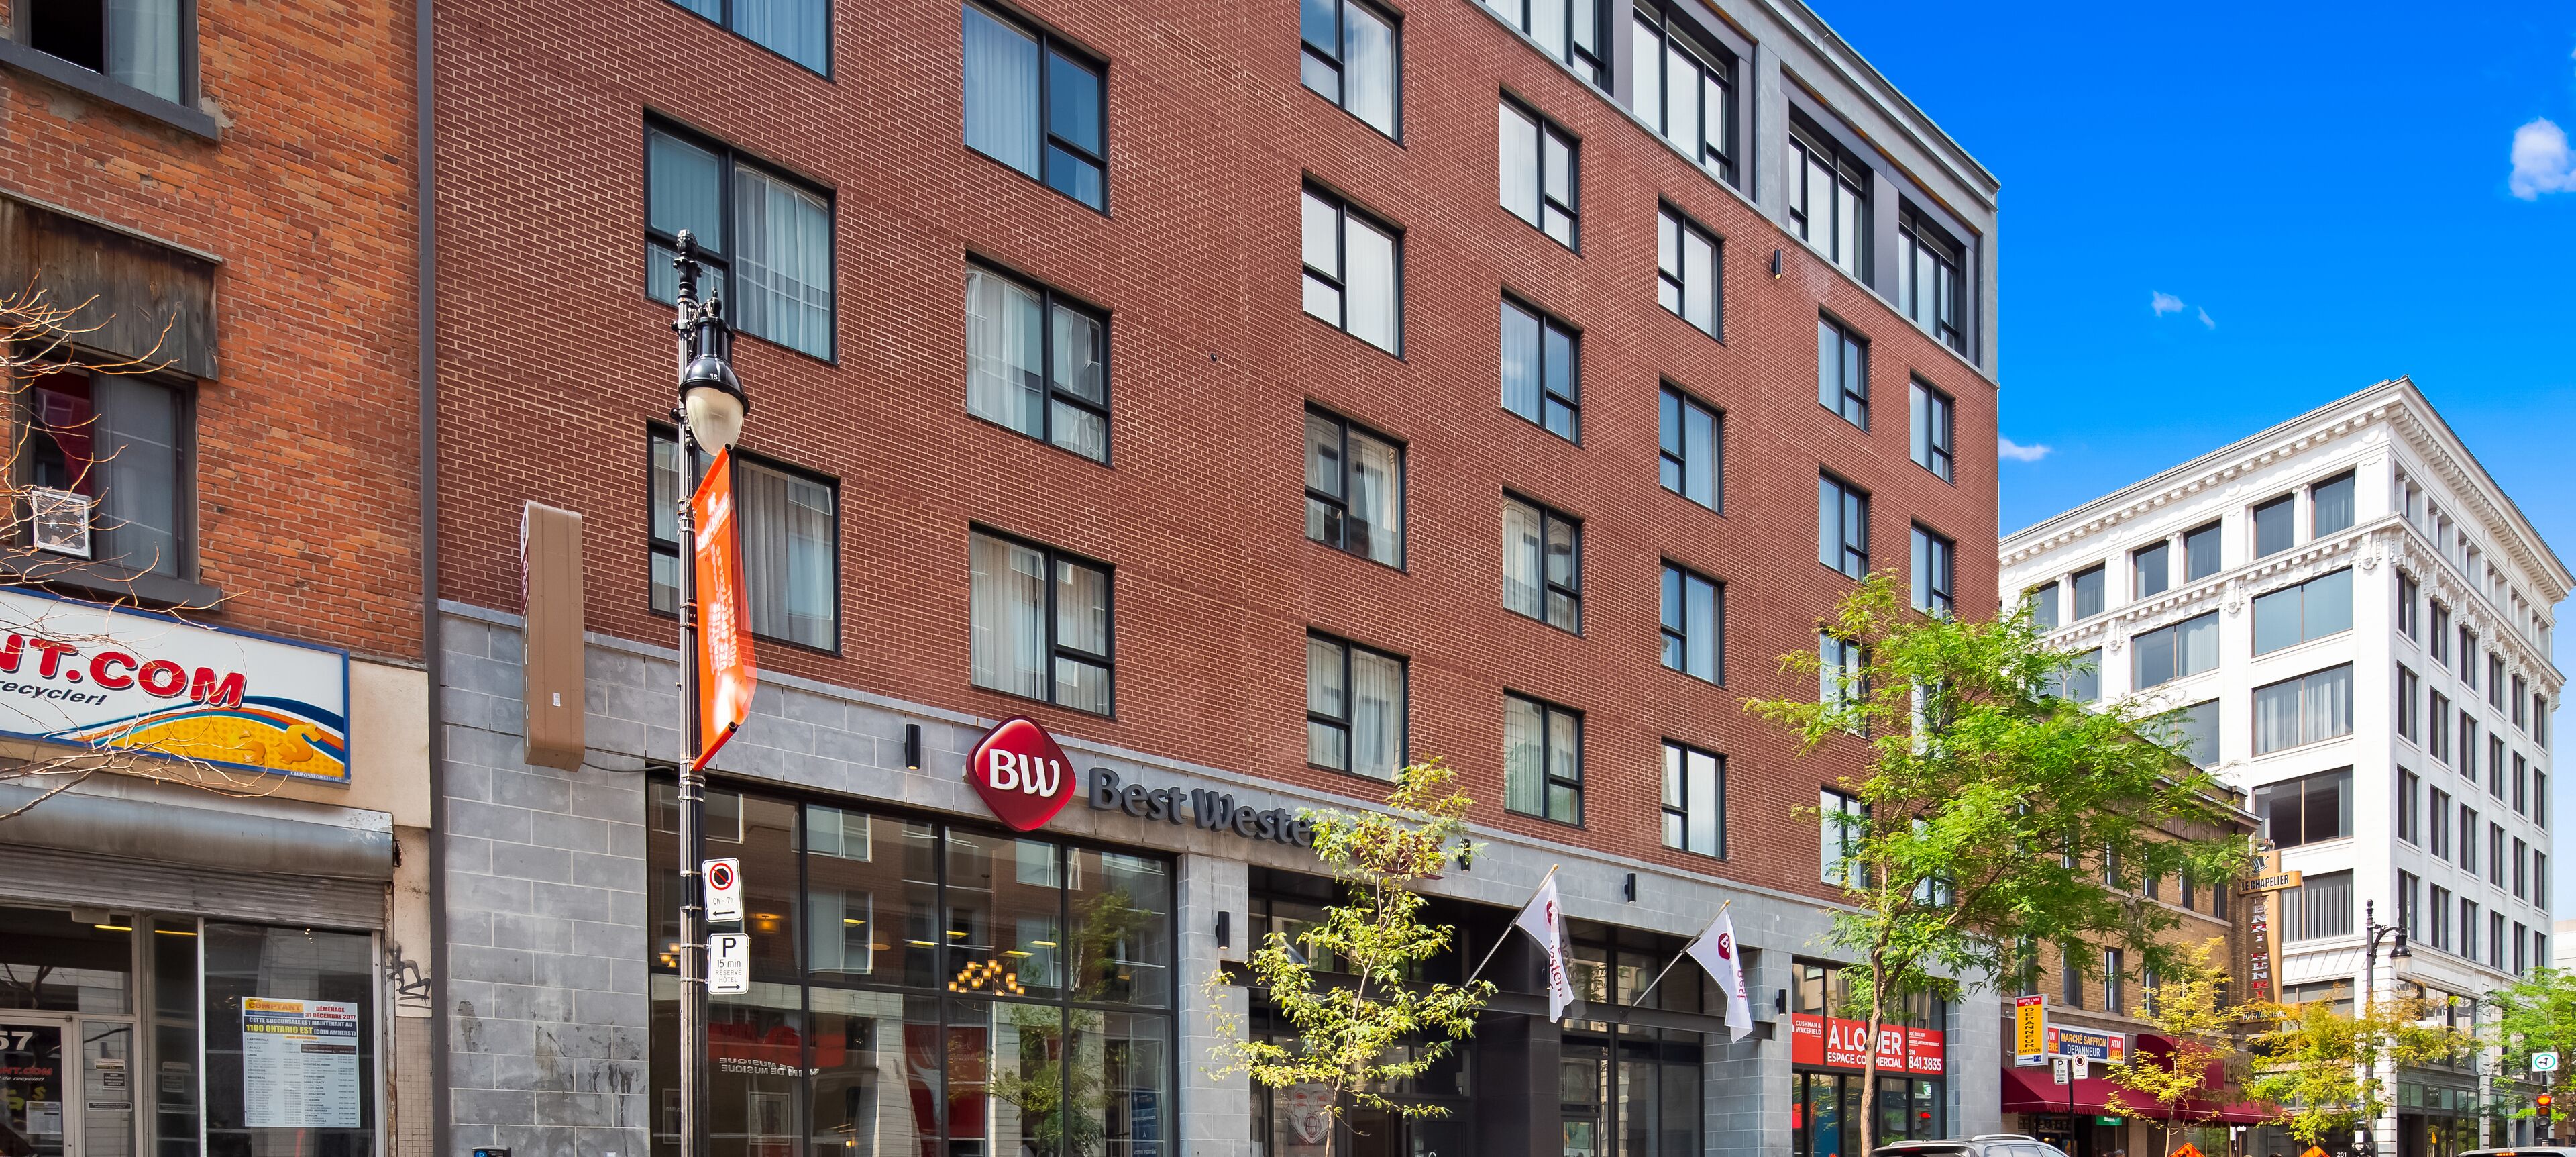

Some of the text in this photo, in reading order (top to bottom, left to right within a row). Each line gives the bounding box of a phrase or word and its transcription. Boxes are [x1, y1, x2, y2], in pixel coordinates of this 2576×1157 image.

[989, 748, 1061, 797] BW
[1089, 766, 1188, 825] Best
[1191, 787, 1316, 848] Weste
[2251, 874, 2289, 889] CHAPELIER
[713, 897, 720, 905] 0h
[722, 937, 737, 958] P
[717, 959, 741, 968] 15 min
[248, 1002, 301, 1011] COMPTANT
[266, 1025, 298, 1034] ONTARIO
[1795, 1020, 1817, 1028] CUSHMAN
[1795, 1026, 1821, 1036] WAKEFIELD
[1828, 1020, 1841, 1050] À
[2061, 1033, 2083, 1044] MARCHÉ
[2084, 1036, 2106, 1047] SAFFRON
[2111, 1040, 2121, 1048] ATM
[2067, 1044, 2101, 1058] DEPANNEUR
[1827, 1052, 1903, 1068] ESPACE COMERCIAL
[1909, 1055, 1941, 1072] 841.3835
[2058, 1060, 2063, 1070] P
